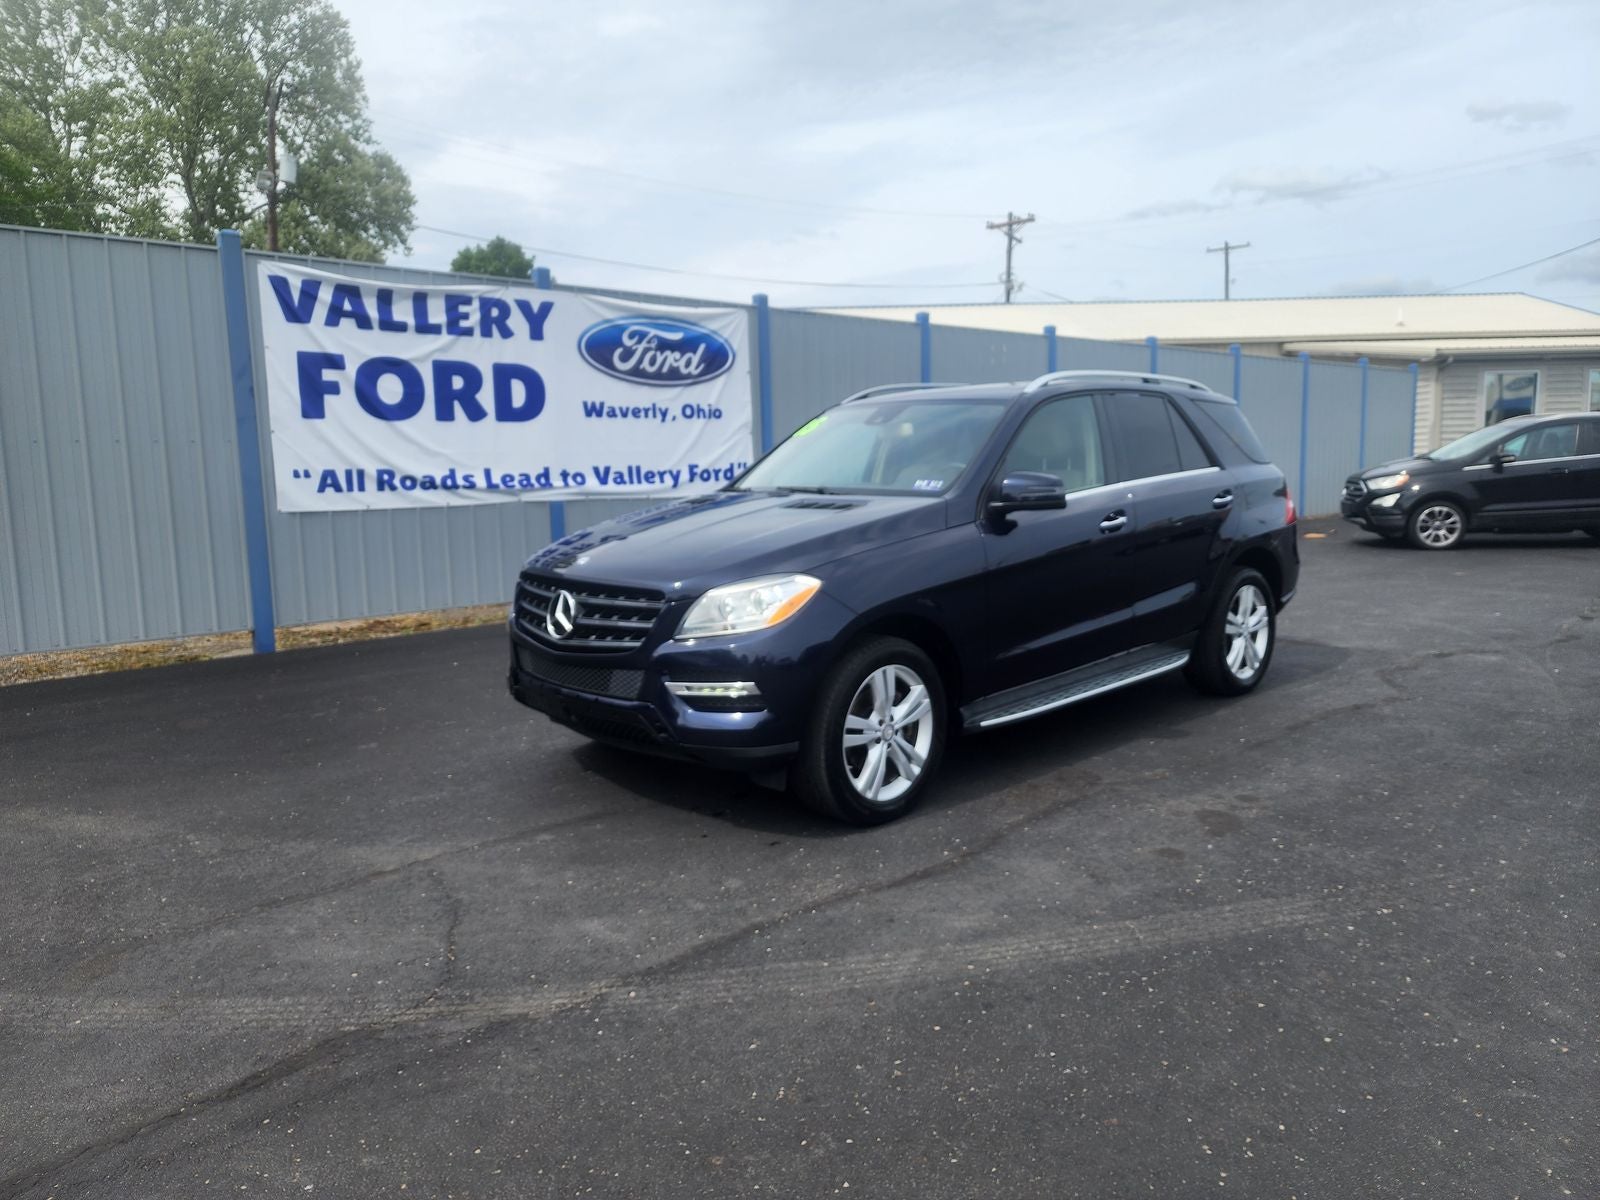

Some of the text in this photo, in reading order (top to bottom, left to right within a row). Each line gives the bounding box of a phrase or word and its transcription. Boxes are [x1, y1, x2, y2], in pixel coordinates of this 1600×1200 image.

[268, 275, 554, 341] VALLERY
[612, 325, 706, 376] Ford
[296, 350, 546, 422] FORD
[582, 401, 722, 422] Waverly, Ohio
[376, 468, 477, 492] Roads
[483, 466, 551, 489] Lead
[559, 468, 586, 488] to
[592, 465, 681, 488] Vallery
